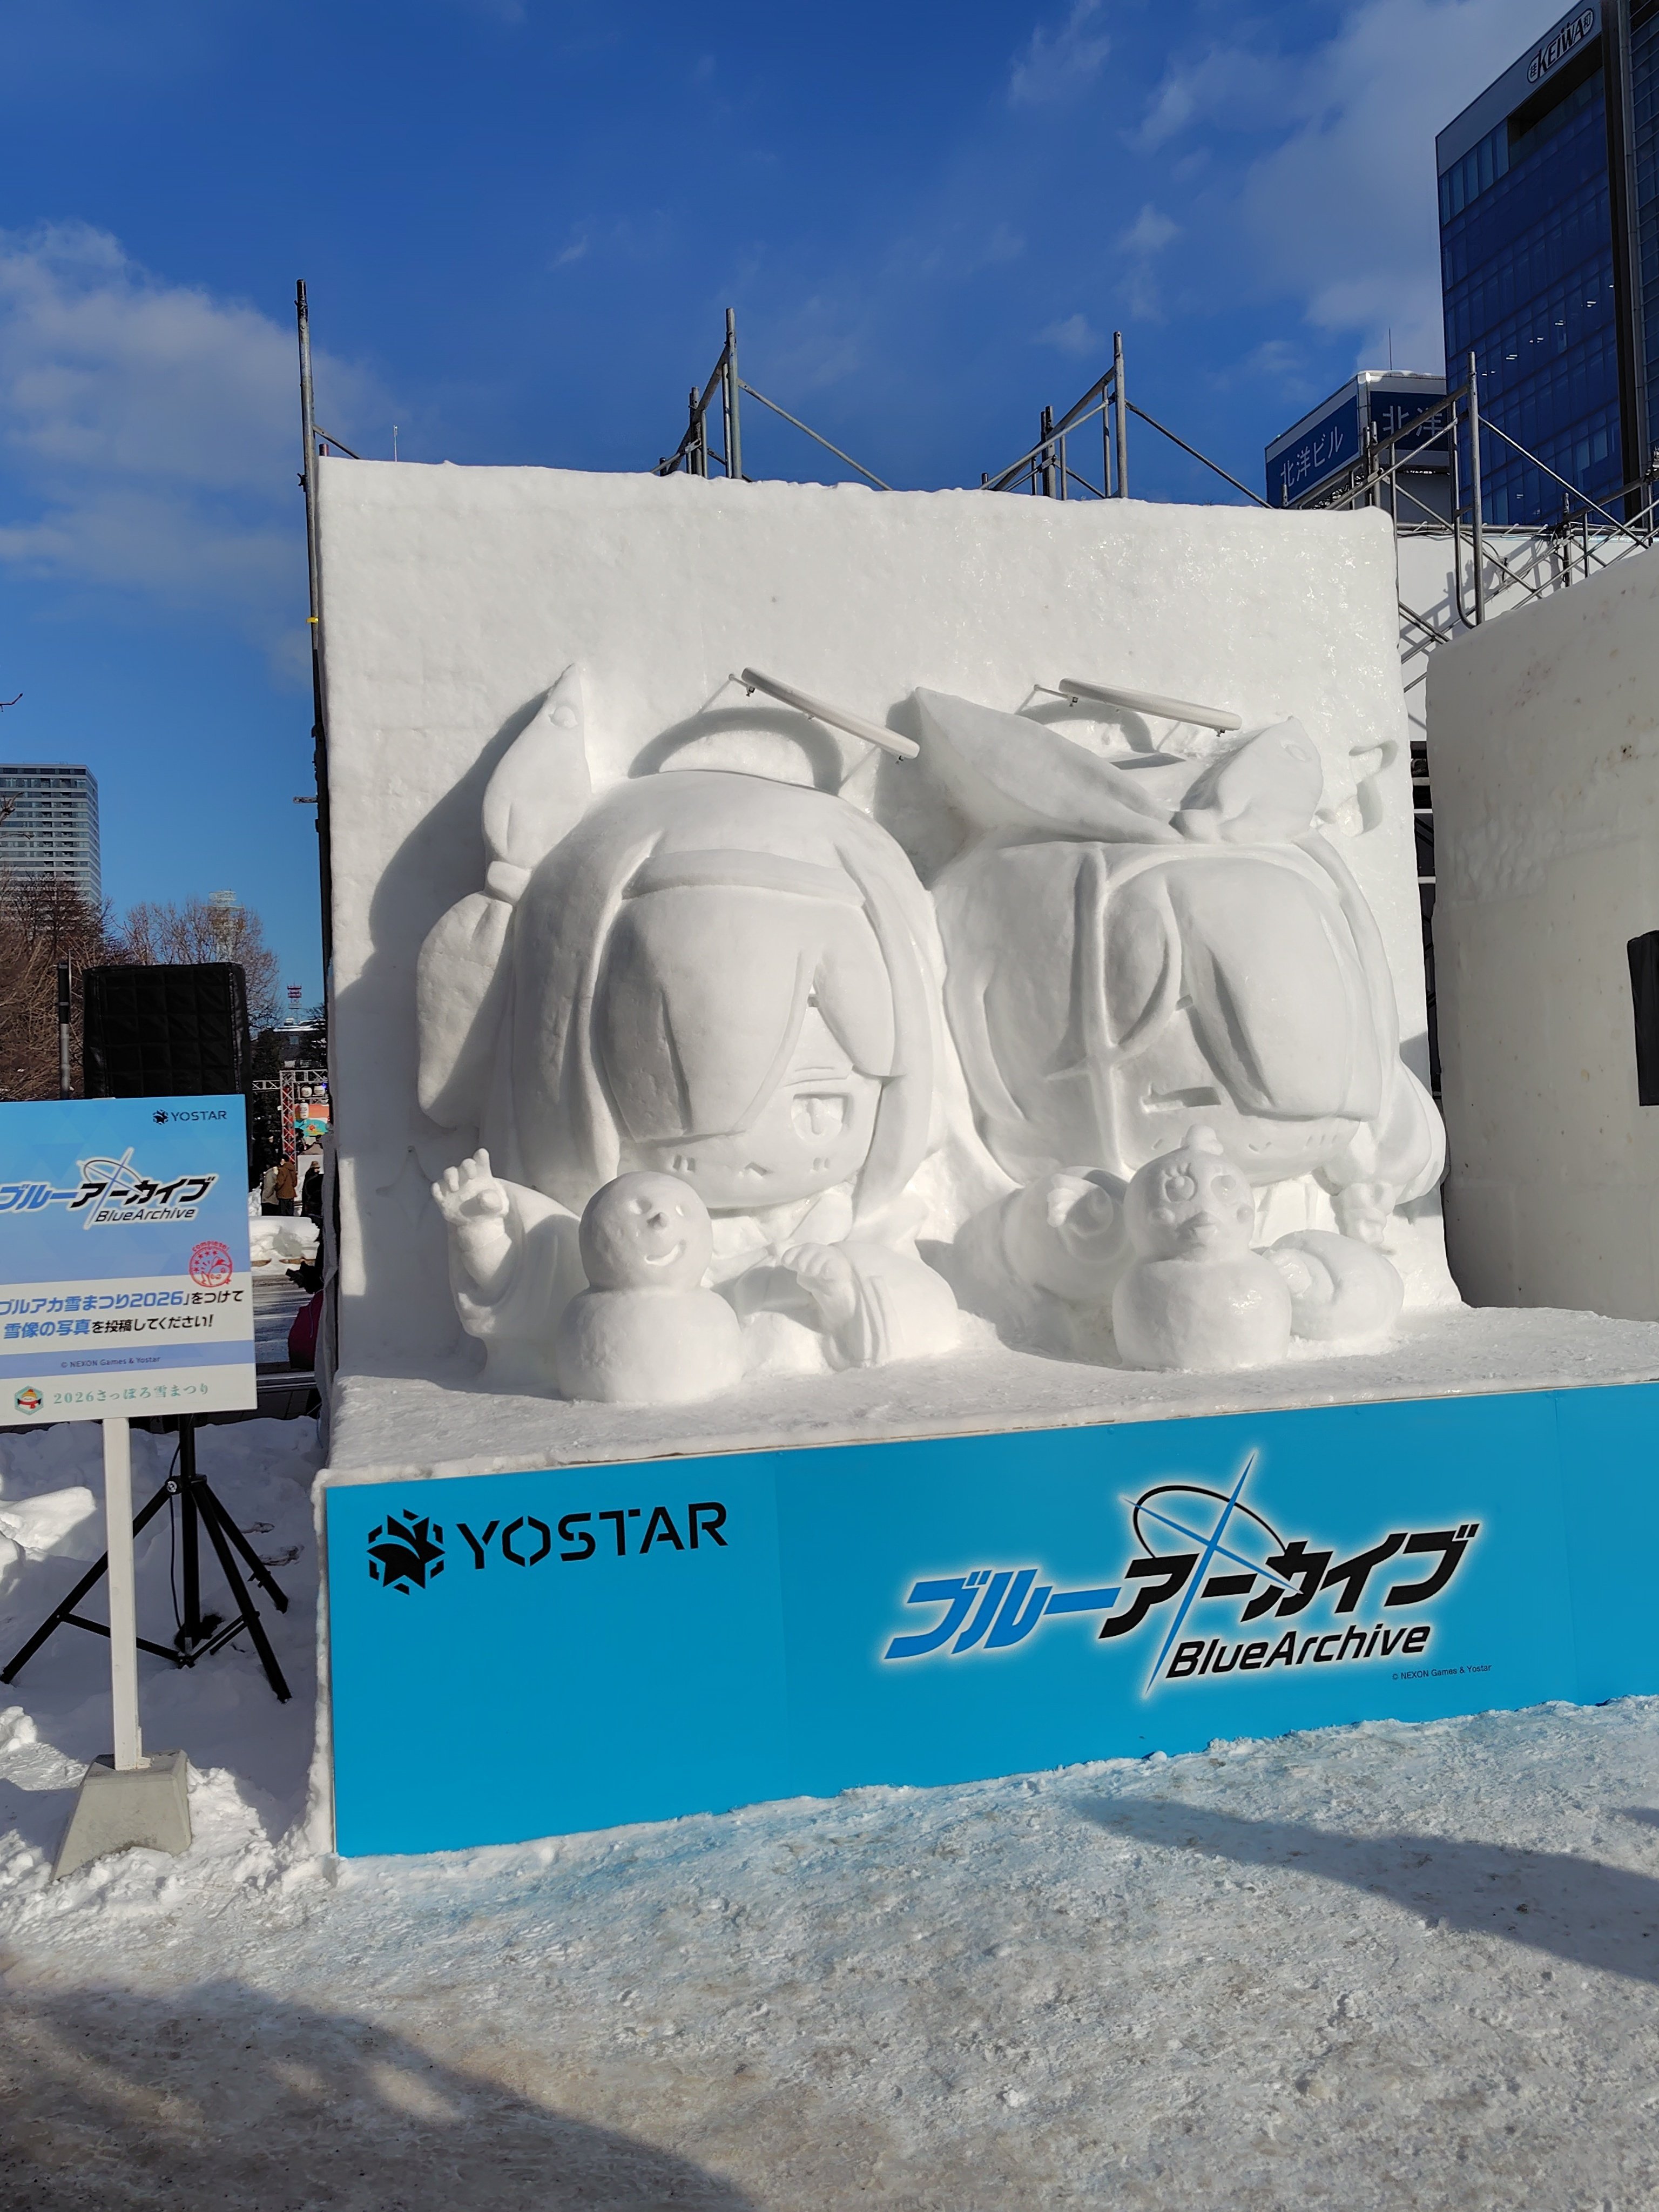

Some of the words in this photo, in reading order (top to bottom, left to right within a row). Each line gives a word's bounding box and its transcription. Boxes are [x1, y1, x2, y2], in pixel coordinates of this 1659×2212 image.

[1382, 405, 1443, 436] 北洋
[1280, 426, 1344, 488] 北洋ビル
[171, 1110, 227, 1122] YOSTAR
[0, 1176, 217, 1210] ブルーアーカイブ
[95, 1207, 195, 1223] BlueArchive
[70, 1359, 98, 1367] NEXON
[99, 1358, 126, 1366] Games
[53, 1382, 208, 1404] 2026さっぽろ雪まつり
[456, 1501, 729, 1569] YOSTAR
[883, 1523, 1480, 1660] ブルーアーカイブ
[1165, 1622, 1431, 1679] BlueArchive
[1401, 1669, 1429, 1680] NEXON
[1431, 1667, 1457, 1677] Games
[1459, 1666, 1465, 1674] &
[1466, 1664, 1492, 1673] Yostar
